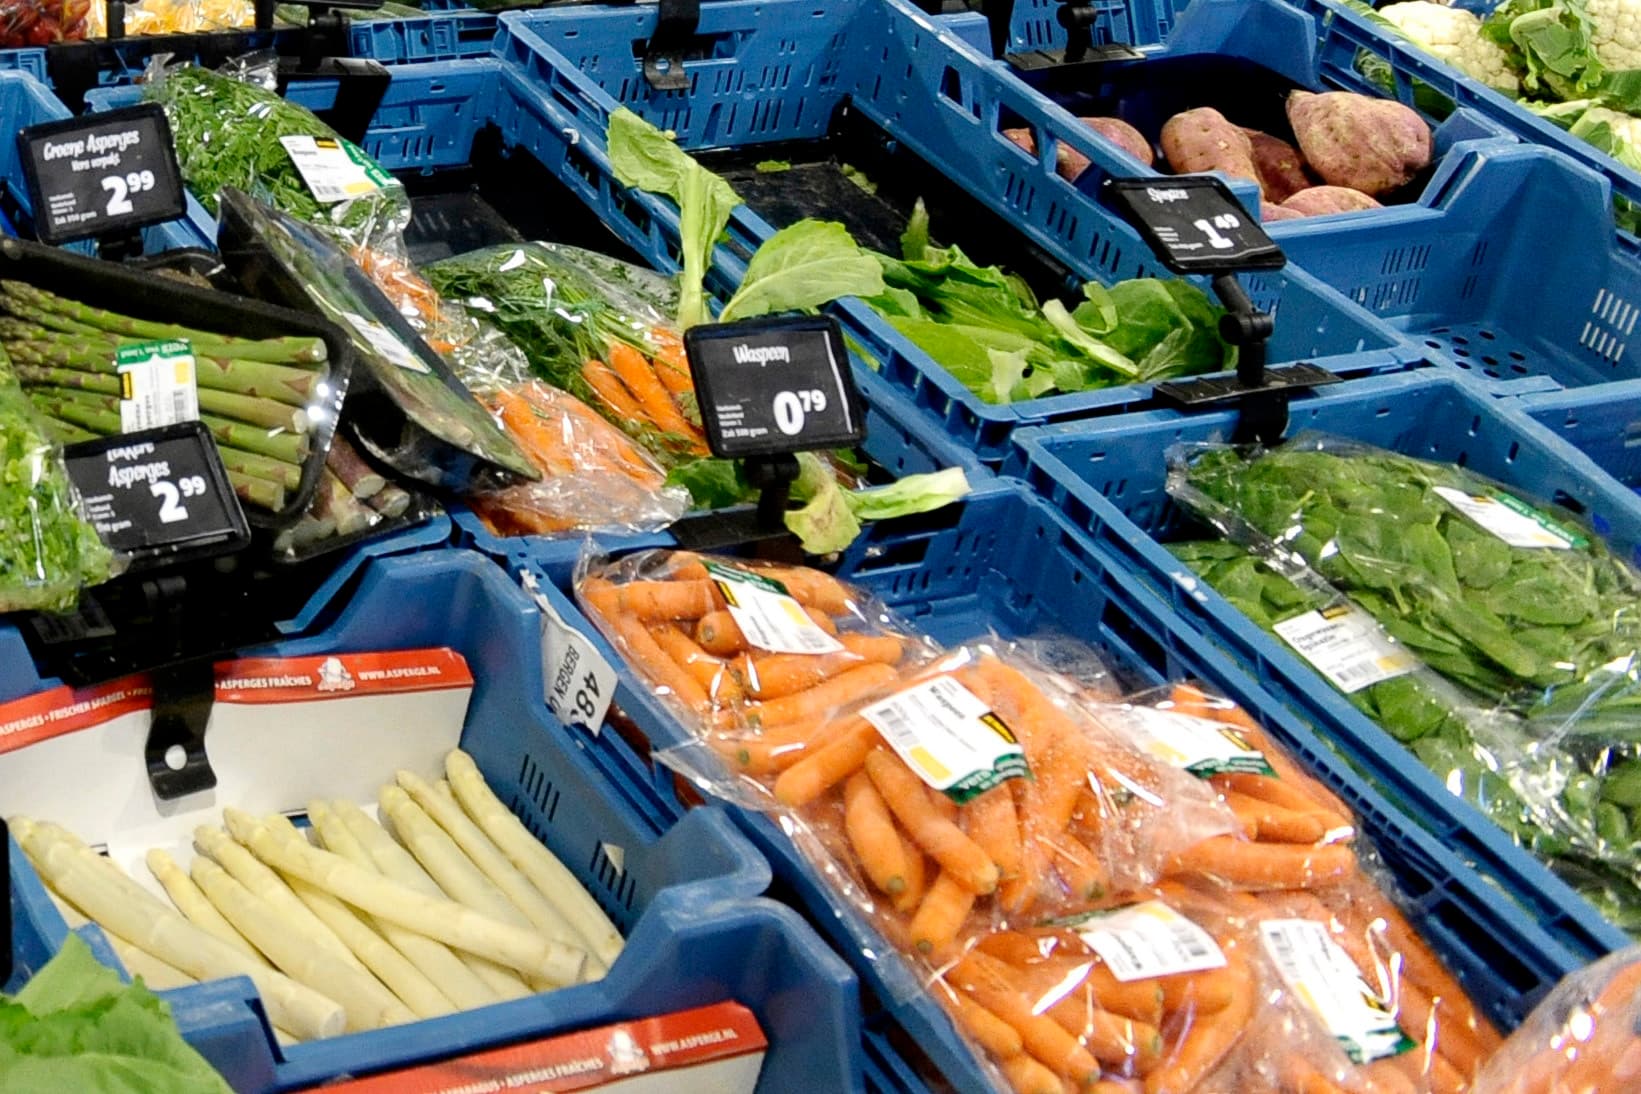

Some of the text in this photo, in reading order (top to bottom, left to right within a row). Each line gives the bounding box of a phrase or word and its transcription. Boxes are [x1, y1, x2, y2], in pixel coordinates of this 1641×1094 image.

[43, 130, 140, 161] Groene Asperges
[733, 344, 789, 366] Waspeen
[108, 461, 170, 489] Asperges
[220, 678, 268, 690] ASPERGES
[268, 674, 312, 689] FRAÎCHES
[357, 666, 441, 682] WWW.ASPERGE.NL
[554, 643, 580, 701] BERGEN
[49, 702, 91, 722] FRISCHER
[505, 1069, 557, 1089] ASPERGES
